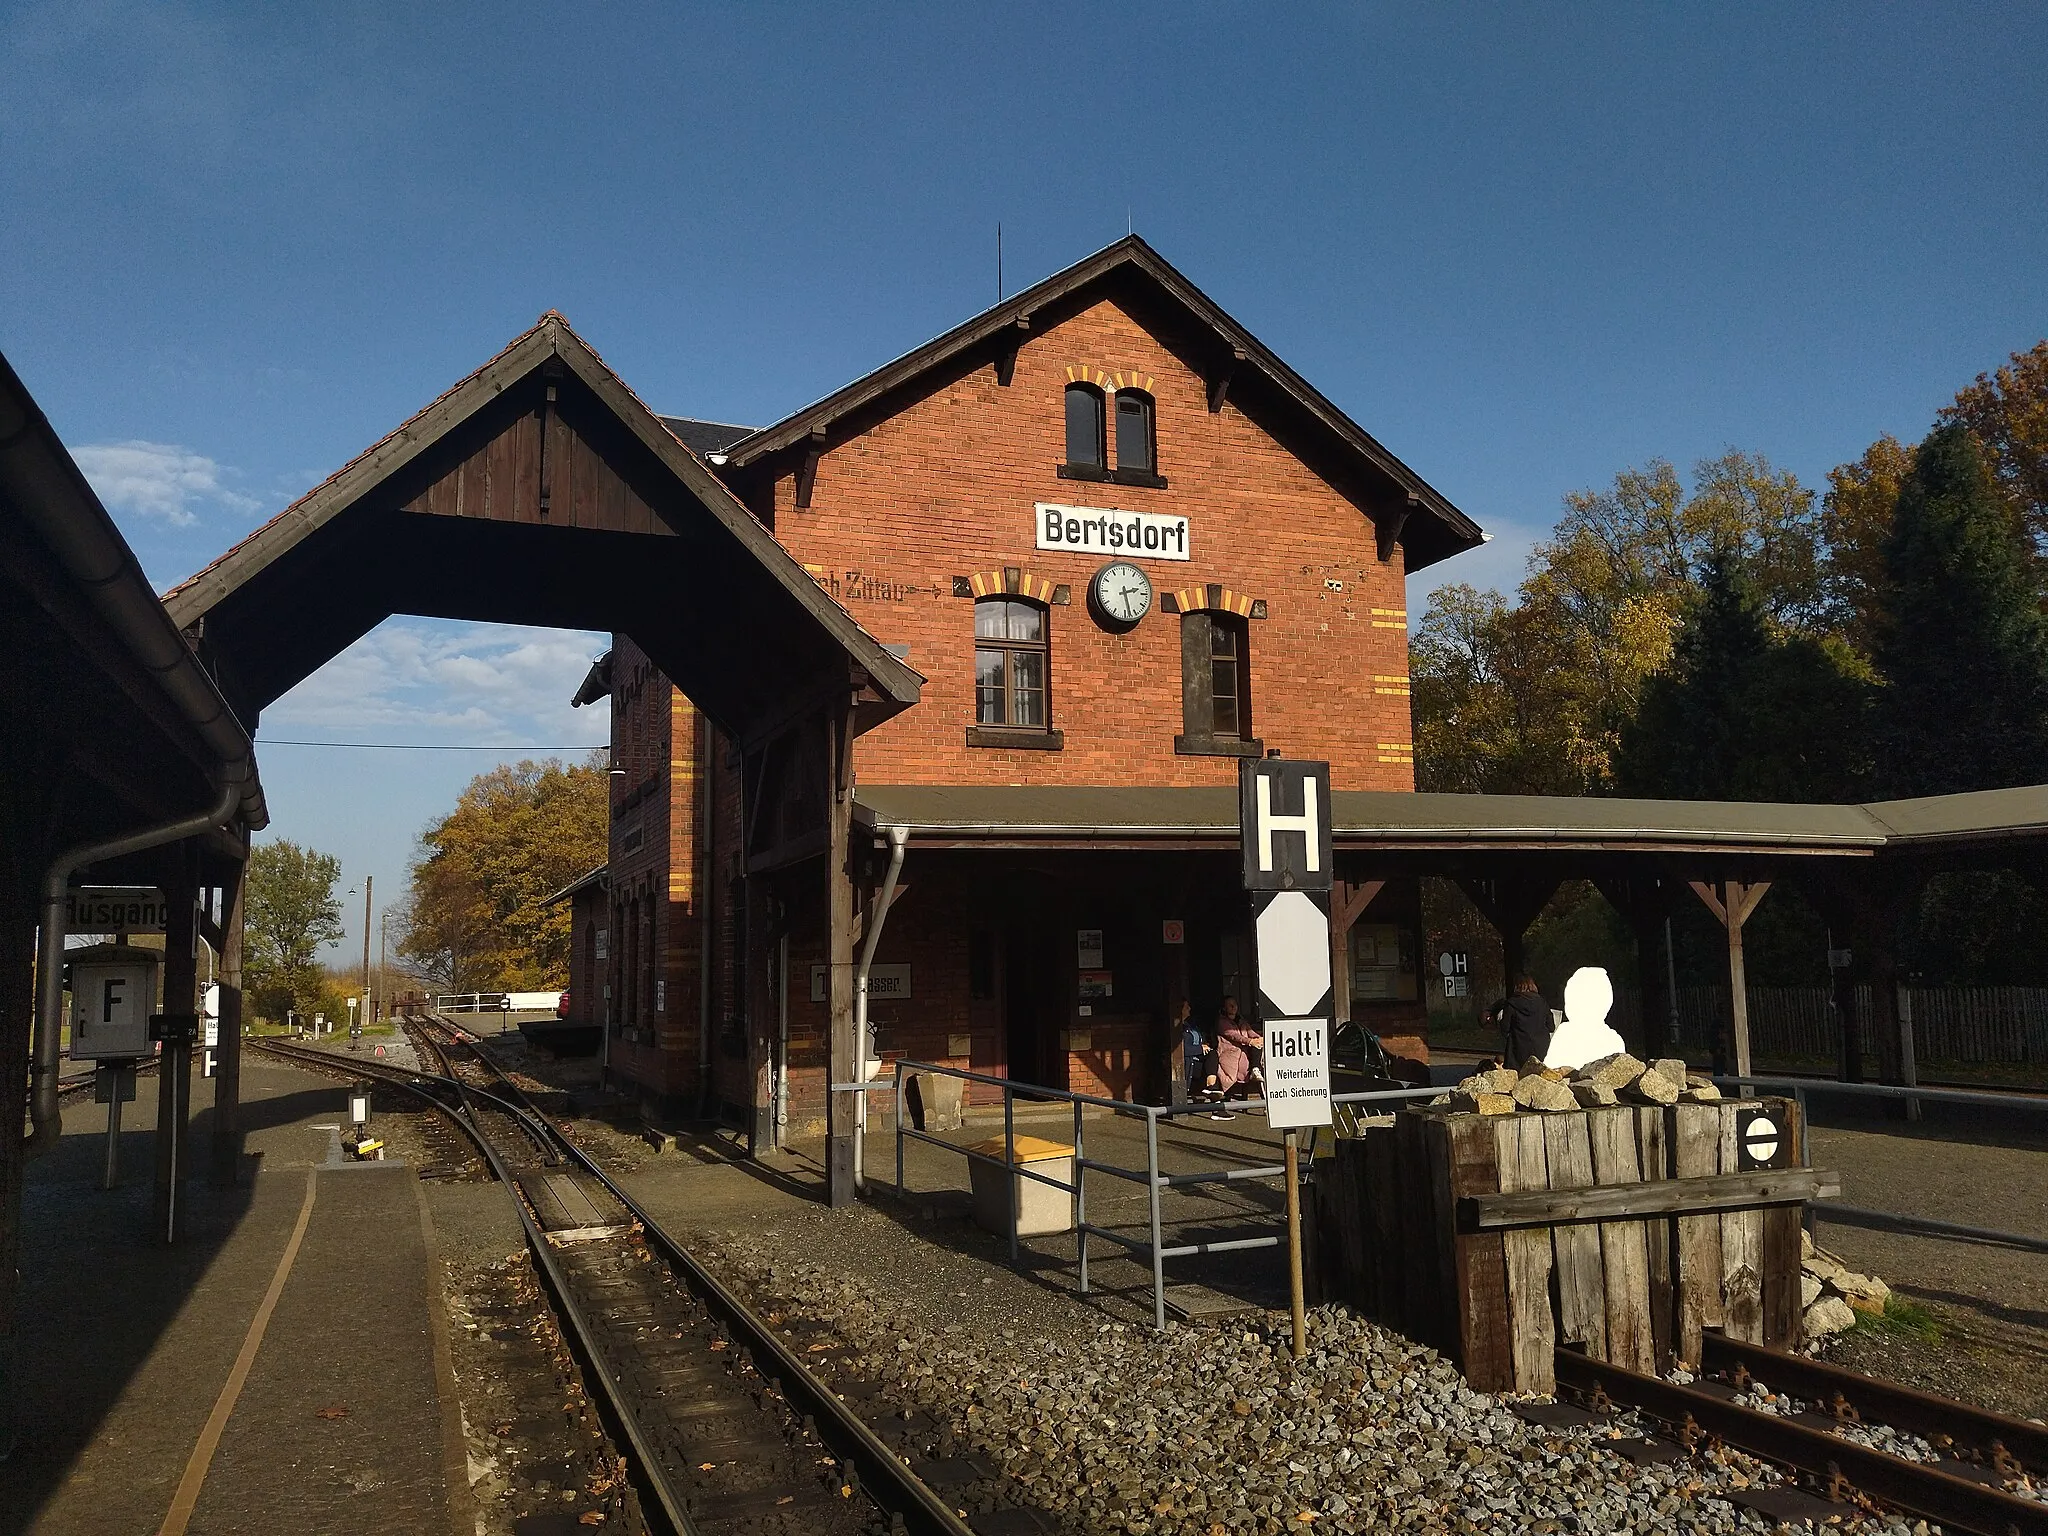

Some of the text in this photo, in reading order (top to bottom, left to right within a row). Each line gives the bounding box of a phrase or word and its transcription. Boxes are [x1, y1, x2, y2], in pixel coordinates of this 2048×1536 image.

[1045, 509, 1184, 552] Bertsdorf
[1257, 774, 1320, 872] H
[1455, 953, 1467, 973] H
[1446, 980, 1454, 994] P
[104, 979, 125, 1022] F
[1276, 1068, 1319, 1080] Weiterfahrt
[1269, 1087, 1328, 1099] nach Sicherung
